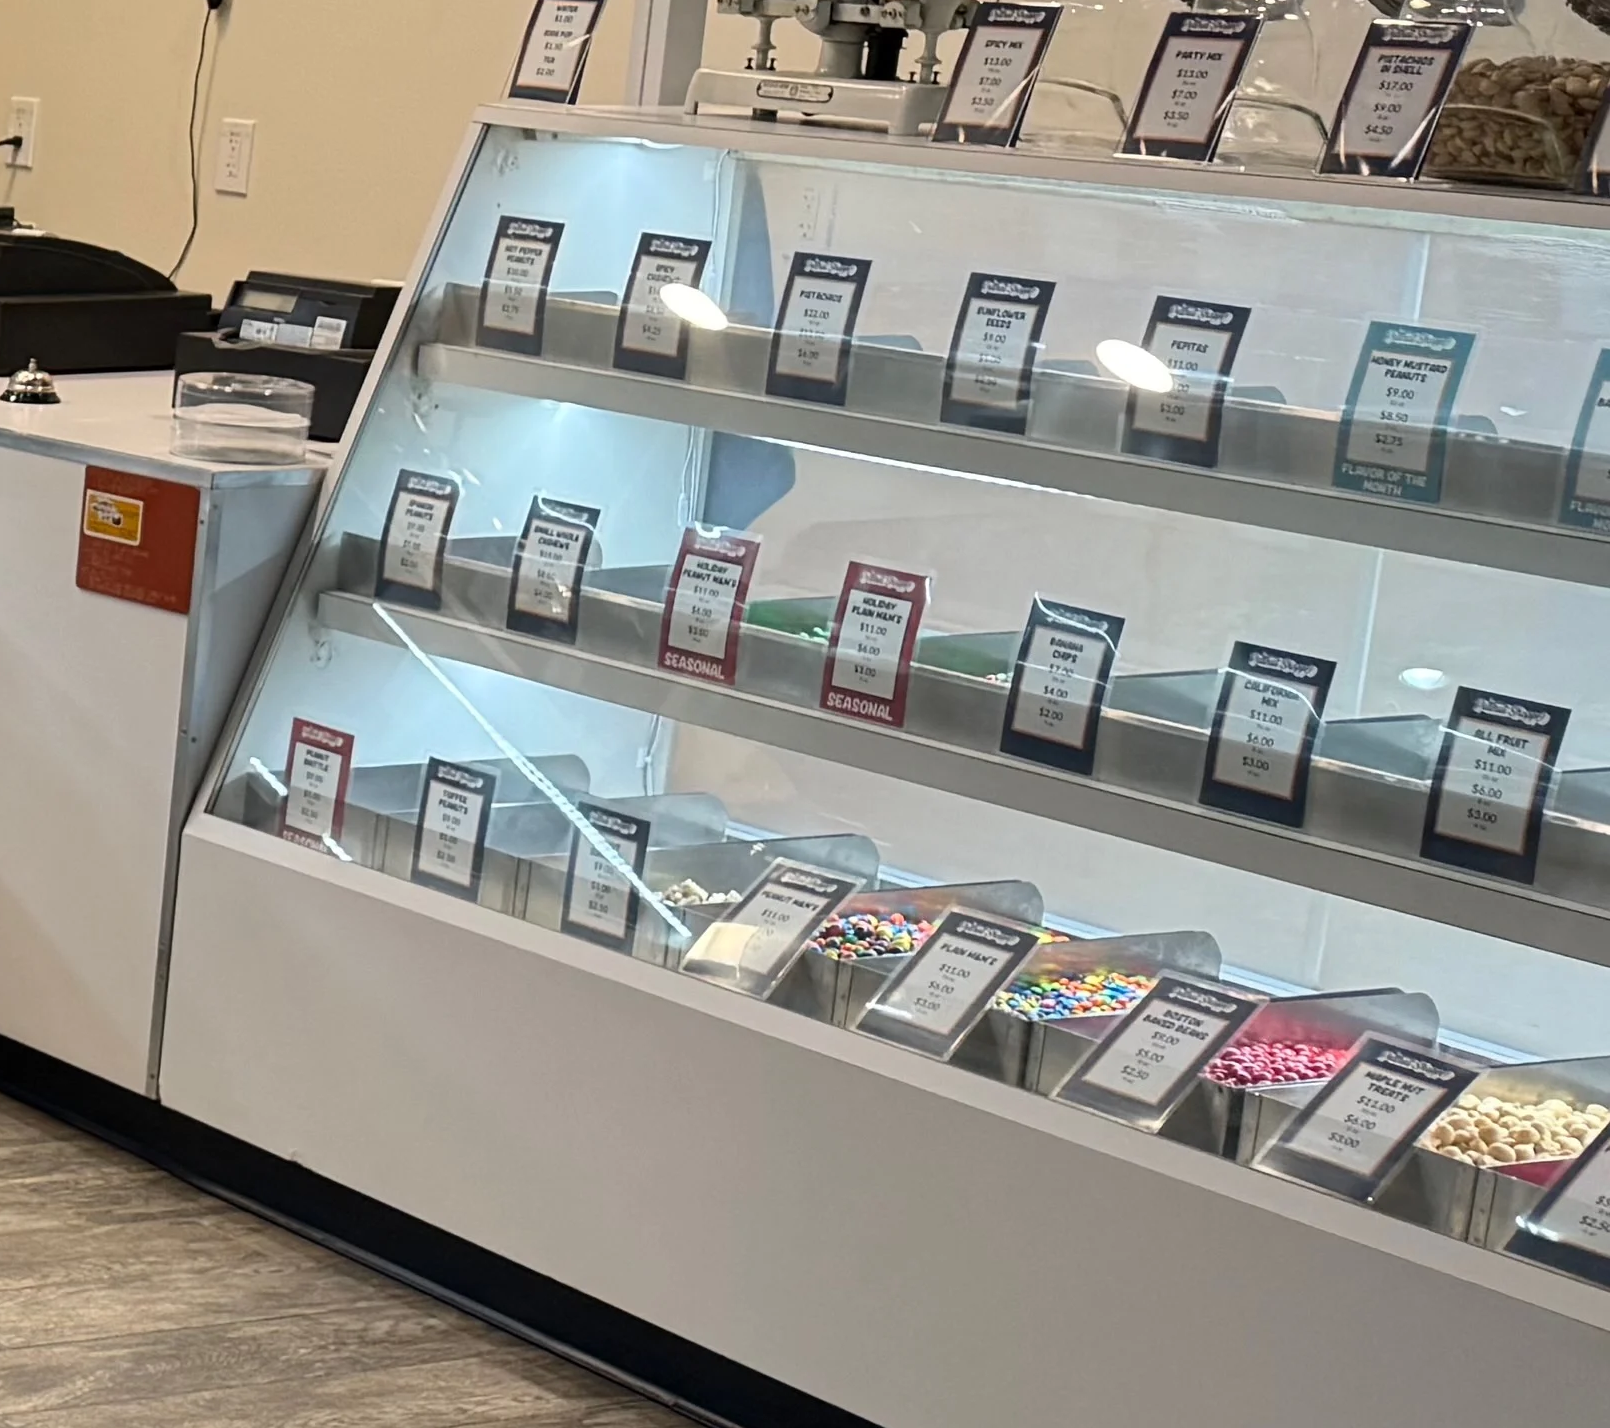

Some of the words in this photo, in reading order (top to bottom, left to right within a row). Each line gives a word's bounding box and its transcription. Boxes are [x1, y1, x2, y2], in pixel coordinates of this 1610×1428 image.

[1175, 50, 1206, 60] PARTY
[1206, 52, 1223, 61] MIX
[1176, 68, 1208, 79] $13.00
[1171, 89, 1198, 100] $7.00
[1163, 110, 1189, 121] $3.50
[1370, 356, 1403, 367] HONEY
[1403, 360, 1448, 374] MUSTARD
[1384, 369, 1427, 383] PEANUTS
[1386, 387, 1415, 400] $9.00
[1341, 463, 1385, 481] FLAVOR
[1386, 469, 1403, 483] OF
[1404, 472, 1428, 487] THE
[1362, 478, 1403, 498] MONTH
[1049, 637, 1083, 653] BANANA
[1052, 649, 1078, 664] CHIPS
[663, 651, 726, 681] SEASONAL
[1043, 685, 1068, 698] $4.00
[1244, 680, 1299, 700] CALIFORNIA
[826, 691, 894, 721] SEASONAL
[1261, 696, 1279, 708] MIX
[1039, 707, 1064, 721] $2.00
[1249, 709, 1283, 725] $11.00
[1246, 732, 1274, 748] $6.00
[1472, 728, 1493, 742] ALL
[1496, 733, 1530, 749] FRUIT
[1487, 745, 1507, 758] MIX
[1242, 756, 1269, 771] $3.00
[1474, 759, 1512, 776] $11.00
[1471, 783, 1503, 799] $6.00
[1467, 808, 1497, 824] $3.00
